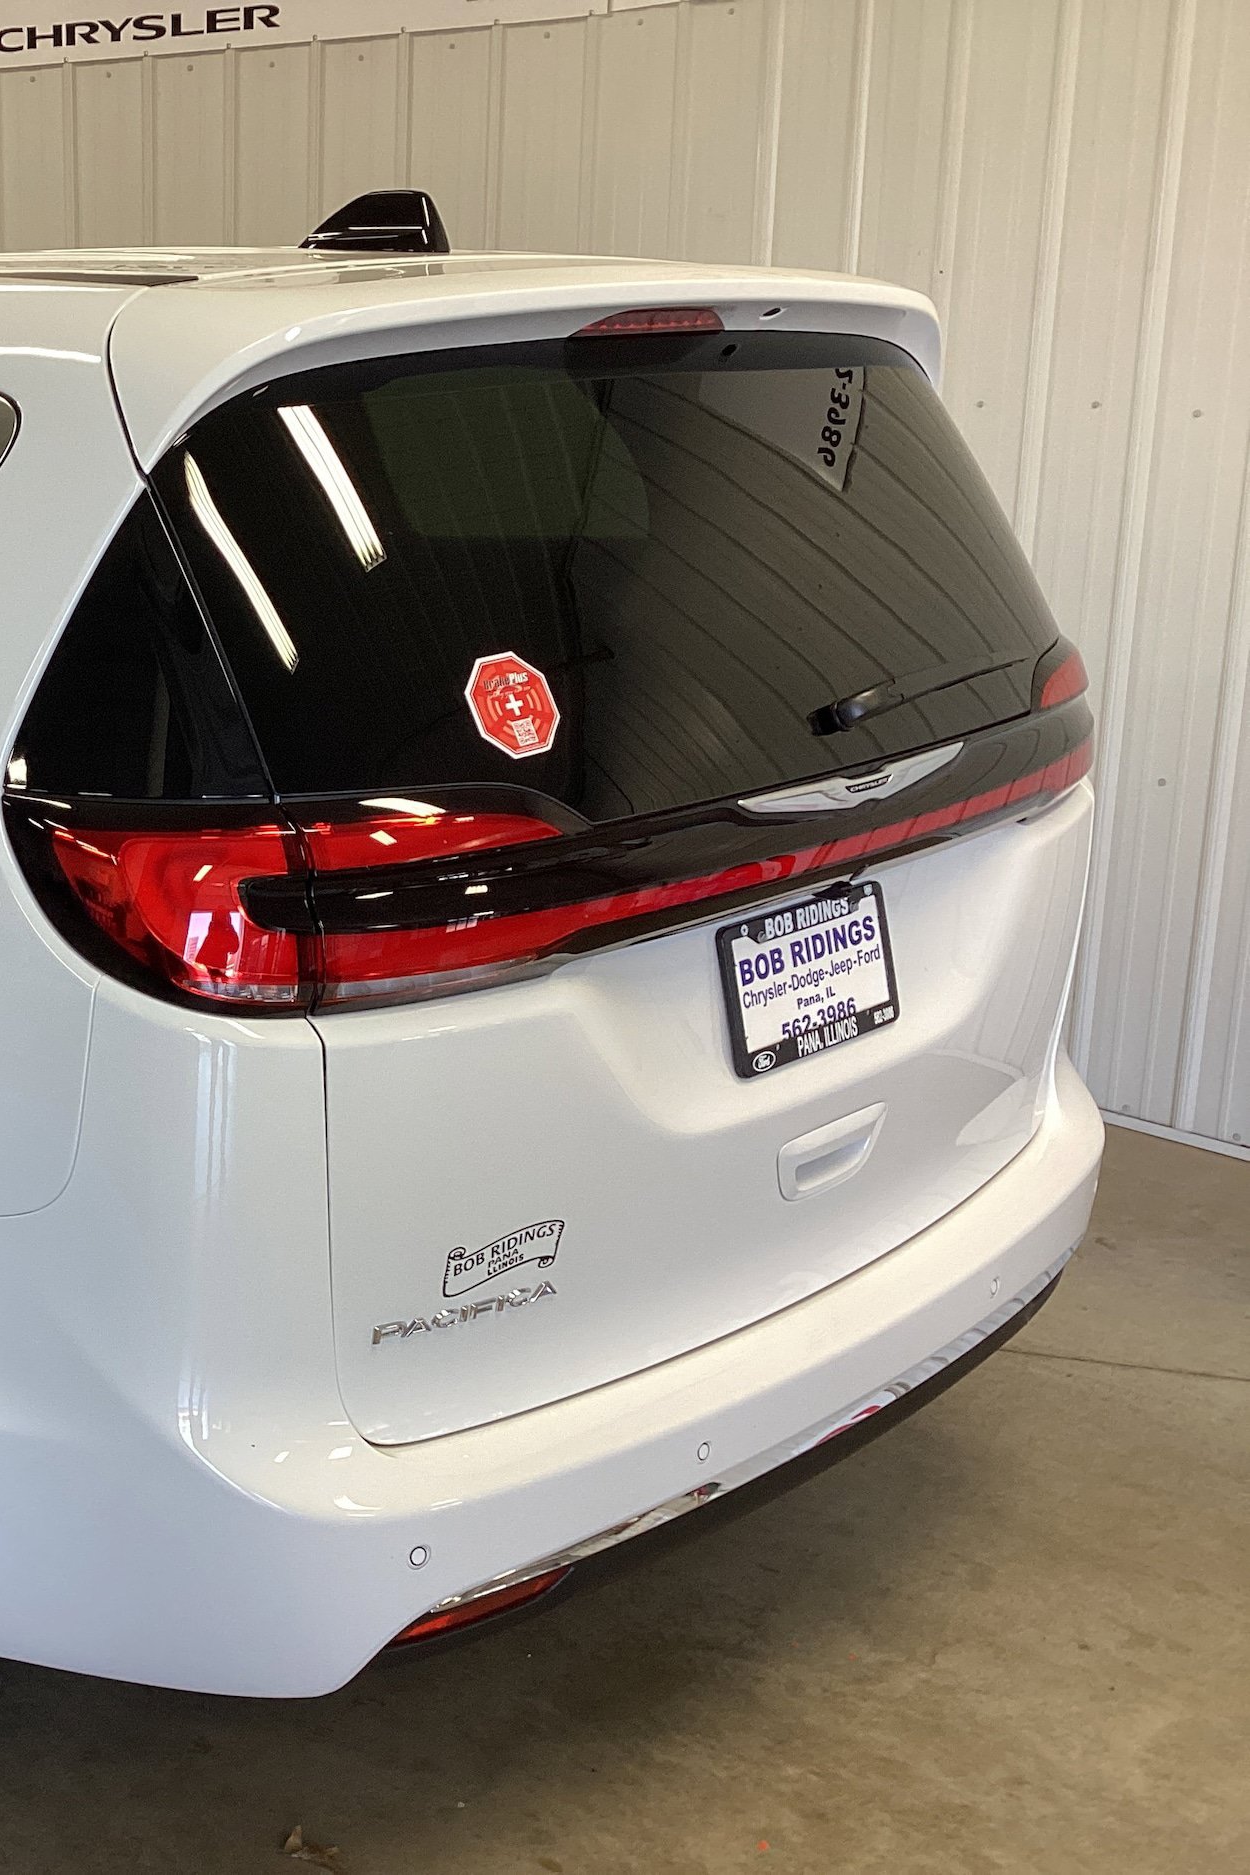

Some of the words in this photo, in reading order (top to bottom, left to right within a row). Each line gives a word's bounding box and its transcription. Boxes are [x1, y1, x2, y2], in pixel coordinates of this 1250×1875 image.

[764, 912, 794, 940] BOB
[795, 897, 849, 930] RIDINGS
[738, 947, 785, 987] BOB
[789, 915, 876, 968] RIDINGS
[742, 944, 881, 1009] Chrysler-Dodge-Jeep-Ford
[796, 993, 824, 1010] Pana,
[825, 986, 836, 999] IL
[782, 997, 856, 1039] 562-3986
[823, 1016, 858, 1048] ILLINOIS
[453, 1252, 485, 1277] BOB
[491, 1223, 557, 1258] RIDINGS
[488, 1248, 519, 1268] PANA
[372, 1280, 557, 1345] PACIFICA
